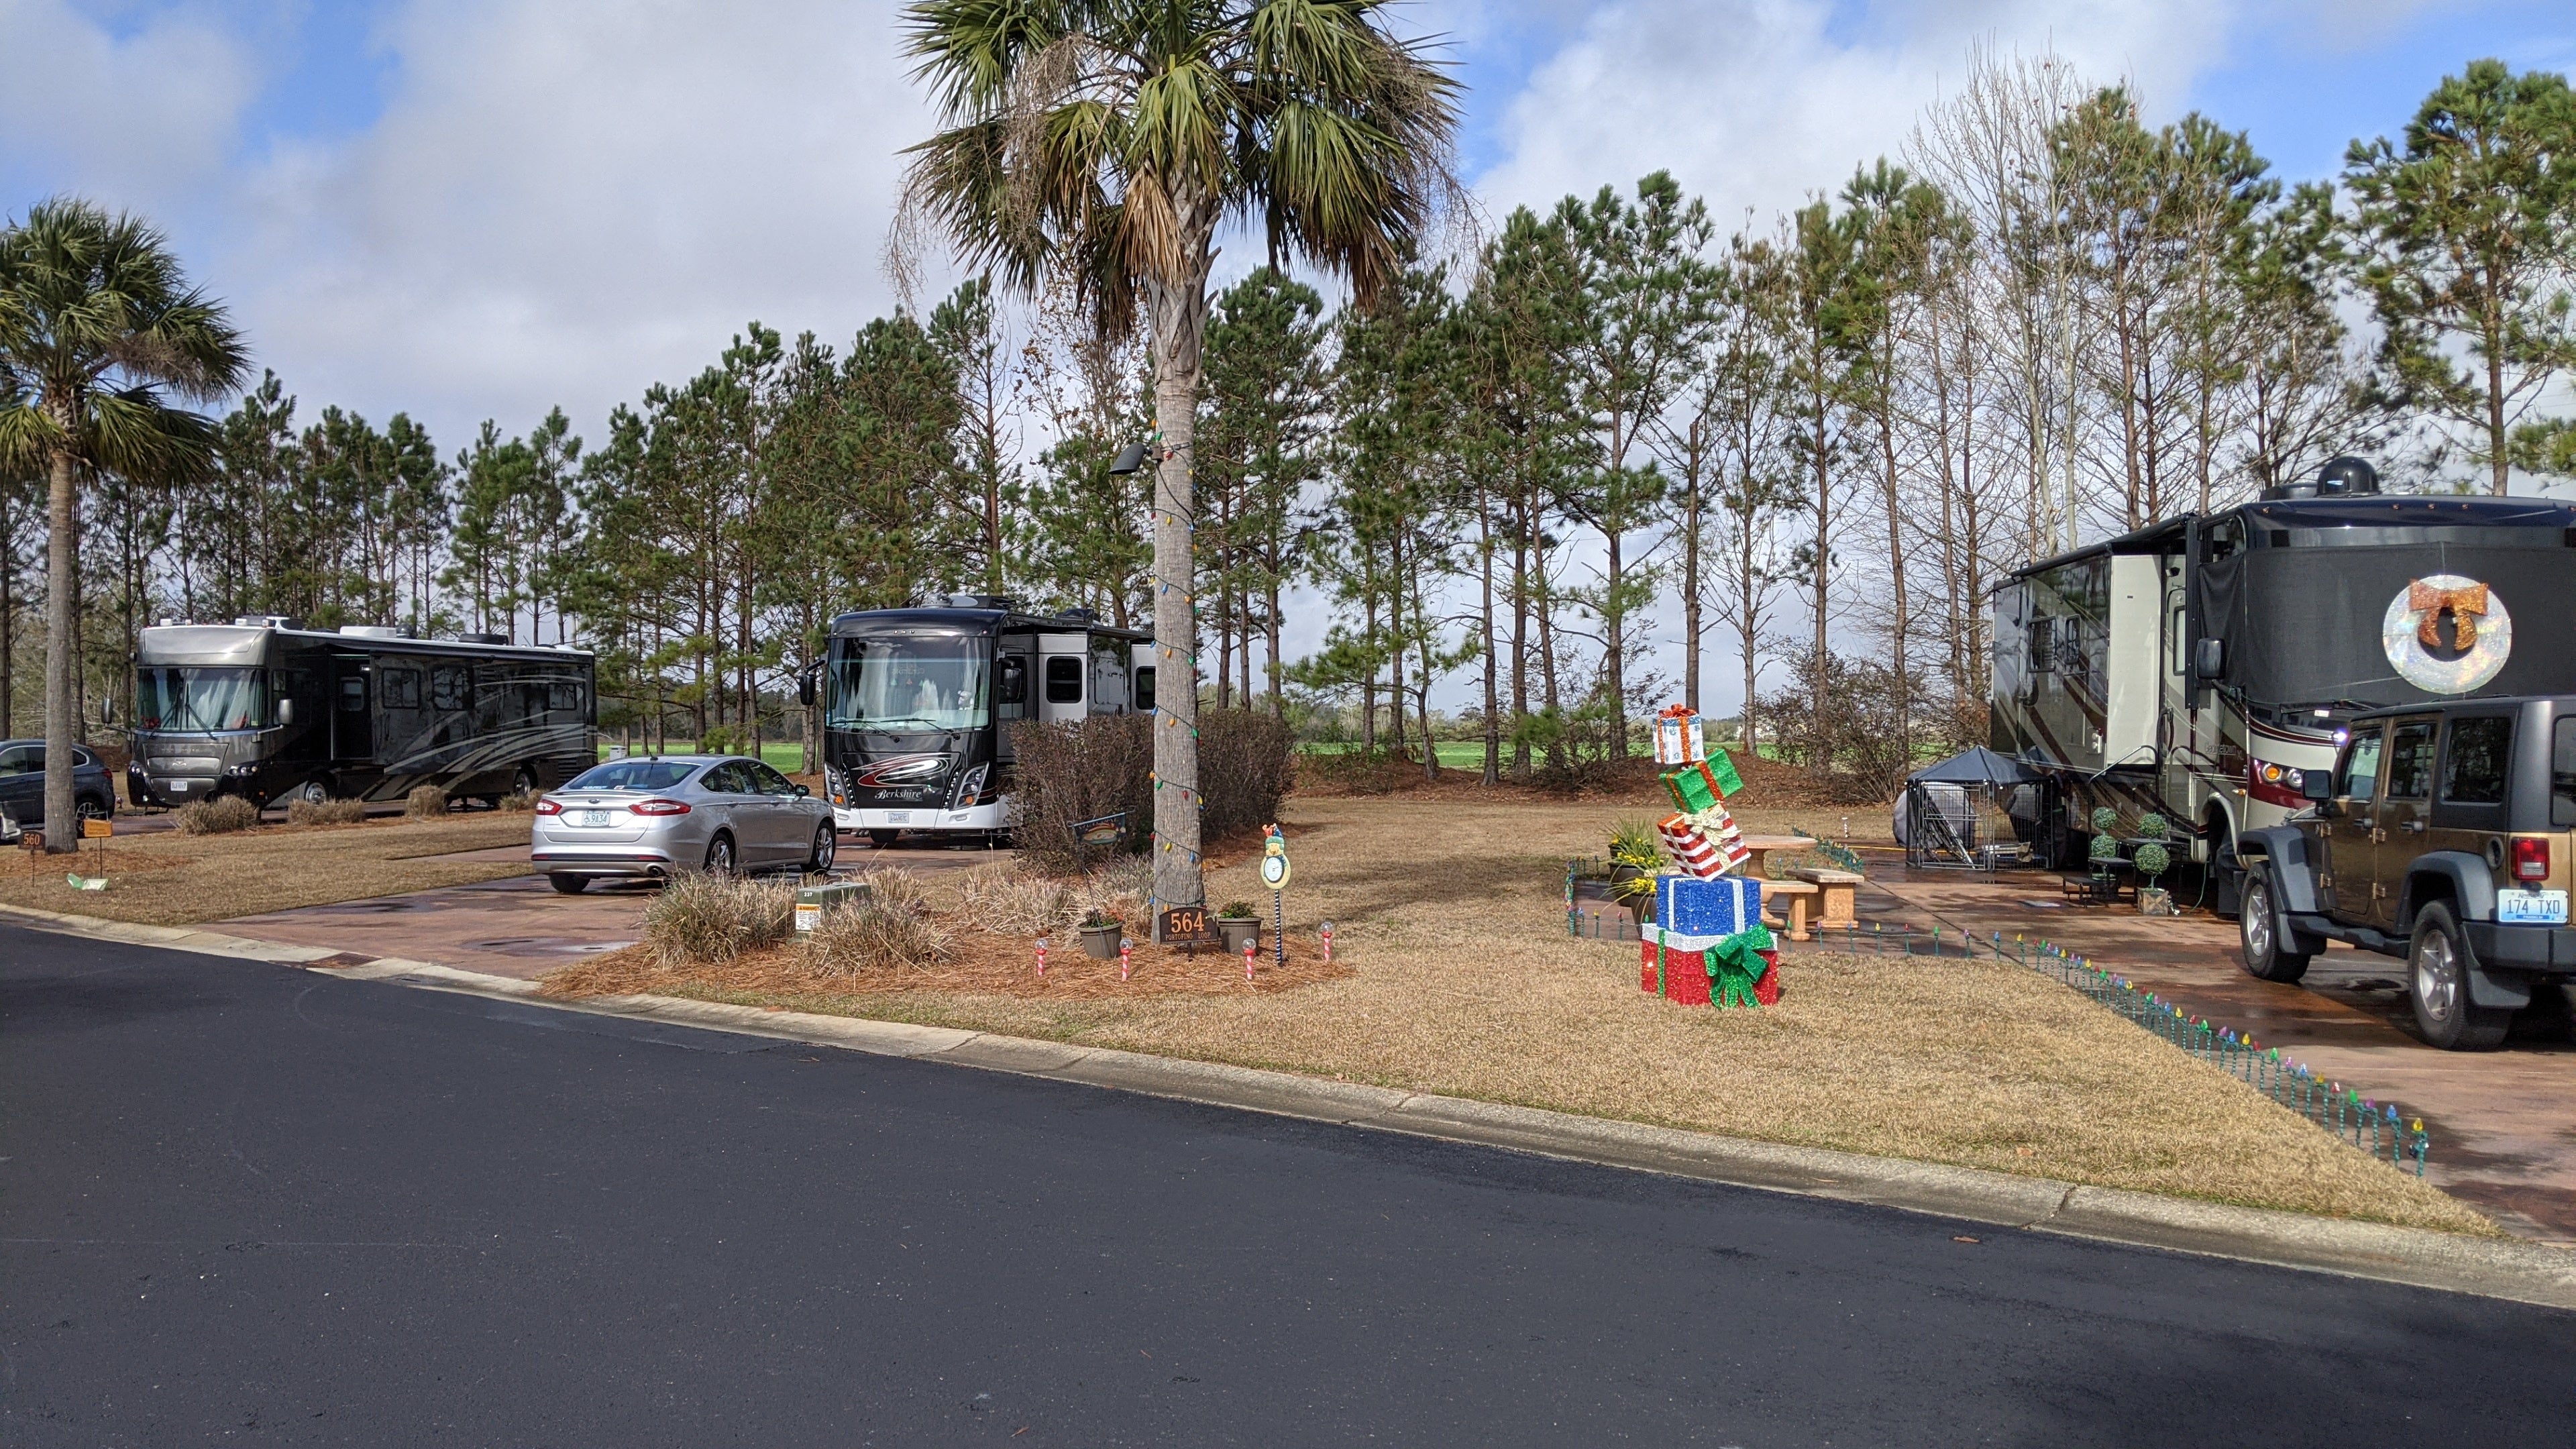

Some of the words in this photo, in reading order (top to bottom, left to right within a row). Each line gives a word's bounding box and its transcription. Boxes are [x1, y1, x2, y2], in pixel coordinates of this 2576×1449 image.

[874, 789, 922, 800] Berkshire
[23, 833, 40, 845] 560
[2507, 900, 2528, 914] 174
[1171, 911, 1205, 933] 564
[1165, 932, 1193, 941] PORTOFINO
